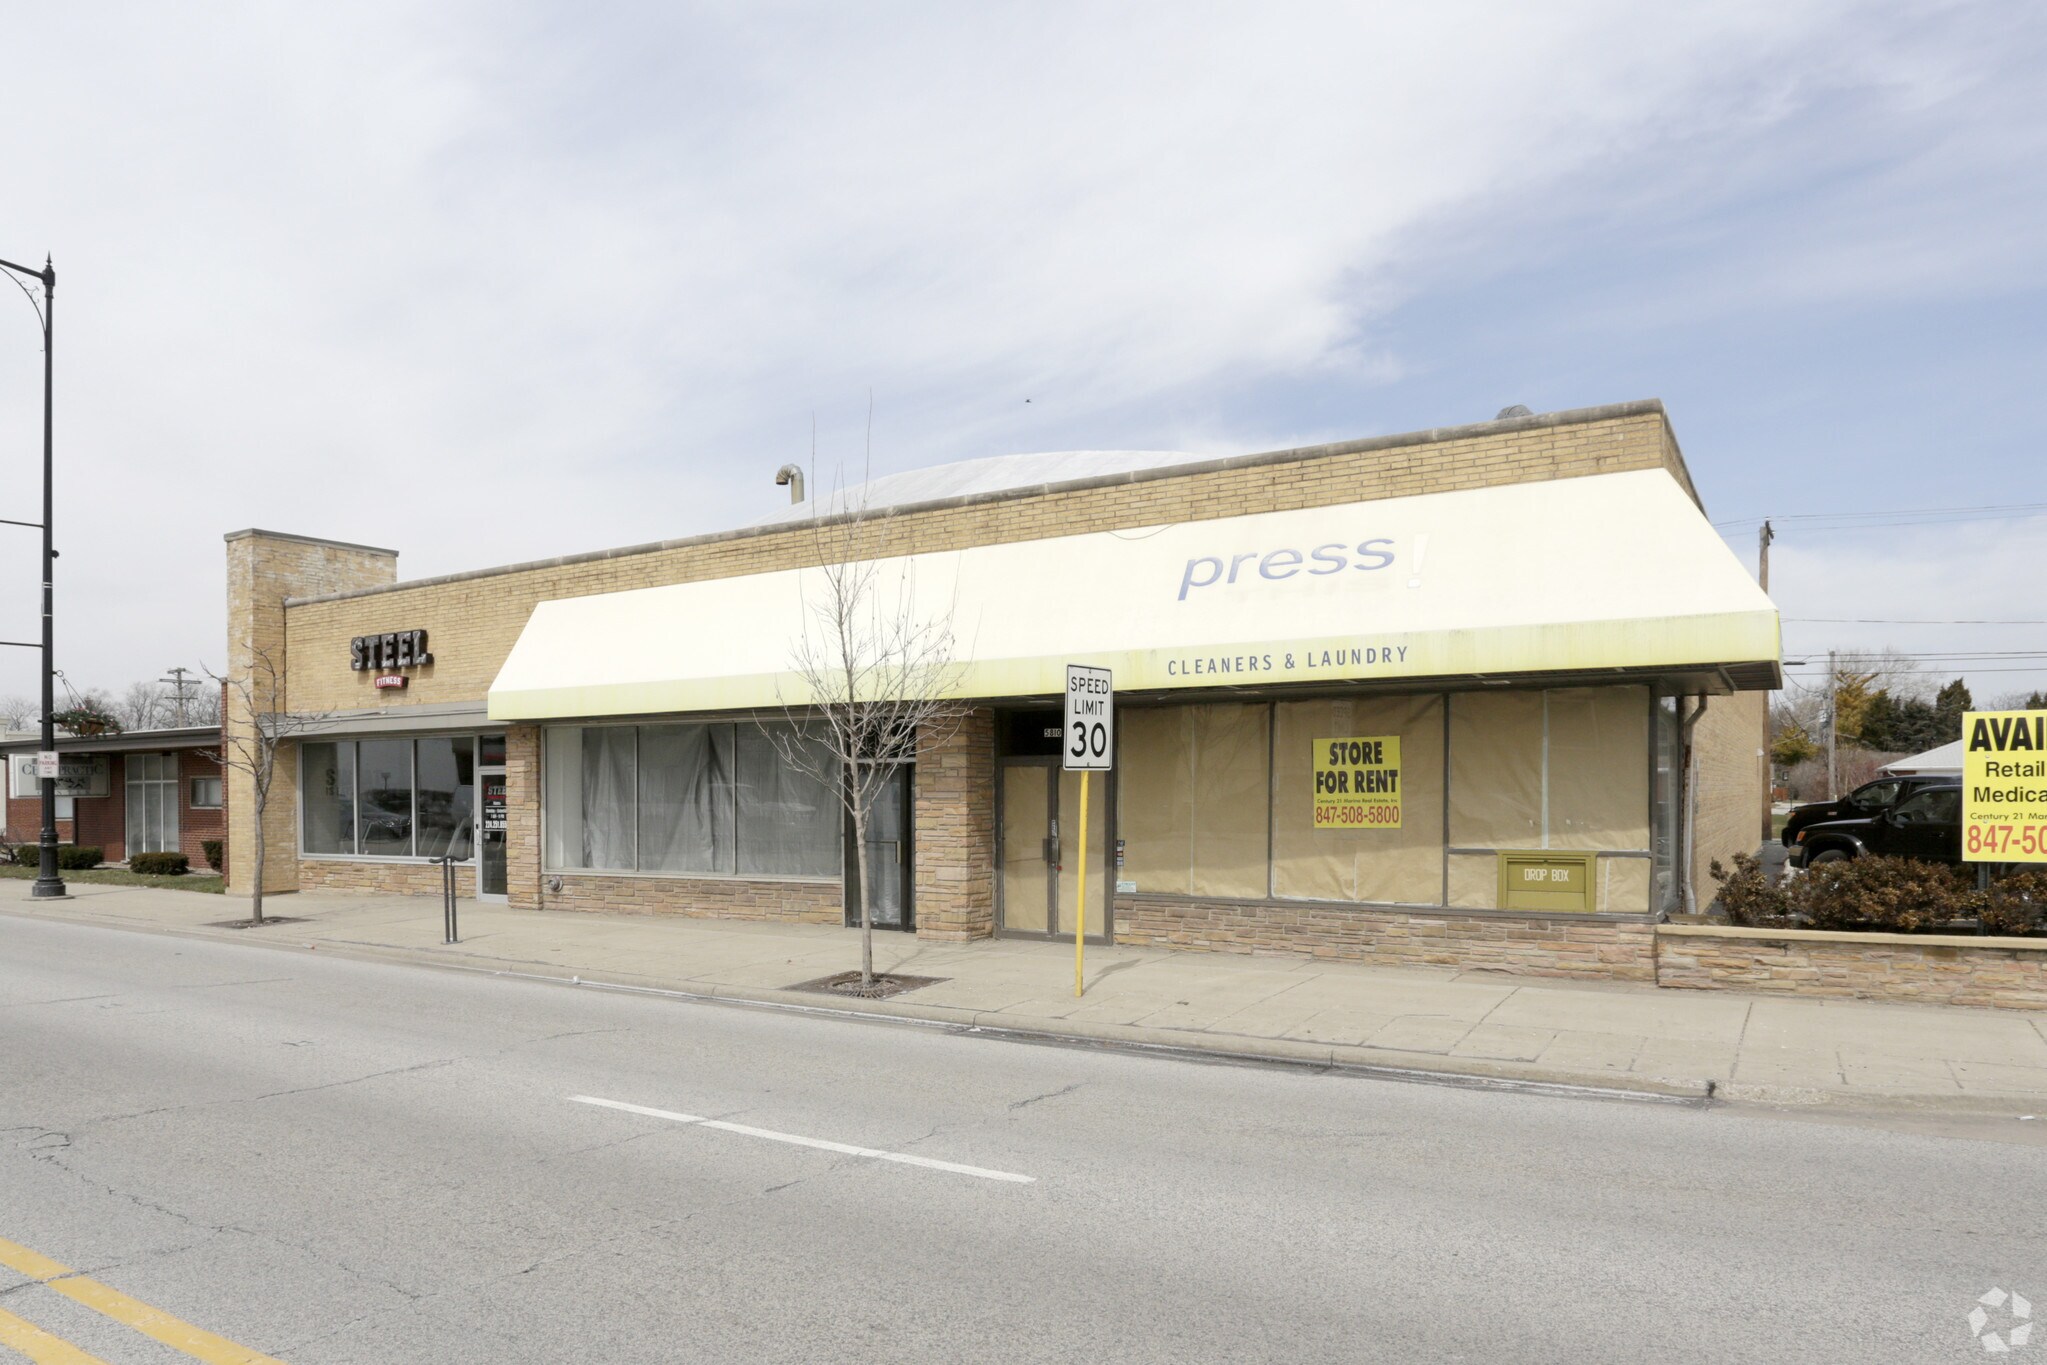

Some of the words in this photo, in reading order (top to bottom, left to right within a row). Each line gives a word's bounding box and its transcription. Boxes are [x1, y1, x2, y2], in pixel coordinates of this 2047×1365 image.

[351, 629, 431, 671] STEEL
[1168, 654, 1272, 676] CLEANERS
[1284, 653, 1295, 669] &
[1307, 646, 1408, 668] LAUNDRY
[376, 676, 402, 687] FITNESS
[1070, 676, 1109, 695] SPEED
[1074, 699, 1104, 715] LIMIT
[1070, 721, 1107, 758] 30
[1969, 717, 2047, 752] AVAI
[1329, 741, 1383, 766] STORE
[1985, 761, 2045, 777] Retail
[488, 785, 507, 796] STEE
[1316, 770, 1349, 794] FOR
[1355, 770, 1398, 793] RENT
[1316, 805, 1400, 824] 847-508-5800
[1970, 812, 2010, 821] Century
[2013, 812, 2024, 820] 21
[1524, 868, 1548, 881] DROP
[1551, 869, 1569, 882] BOX
